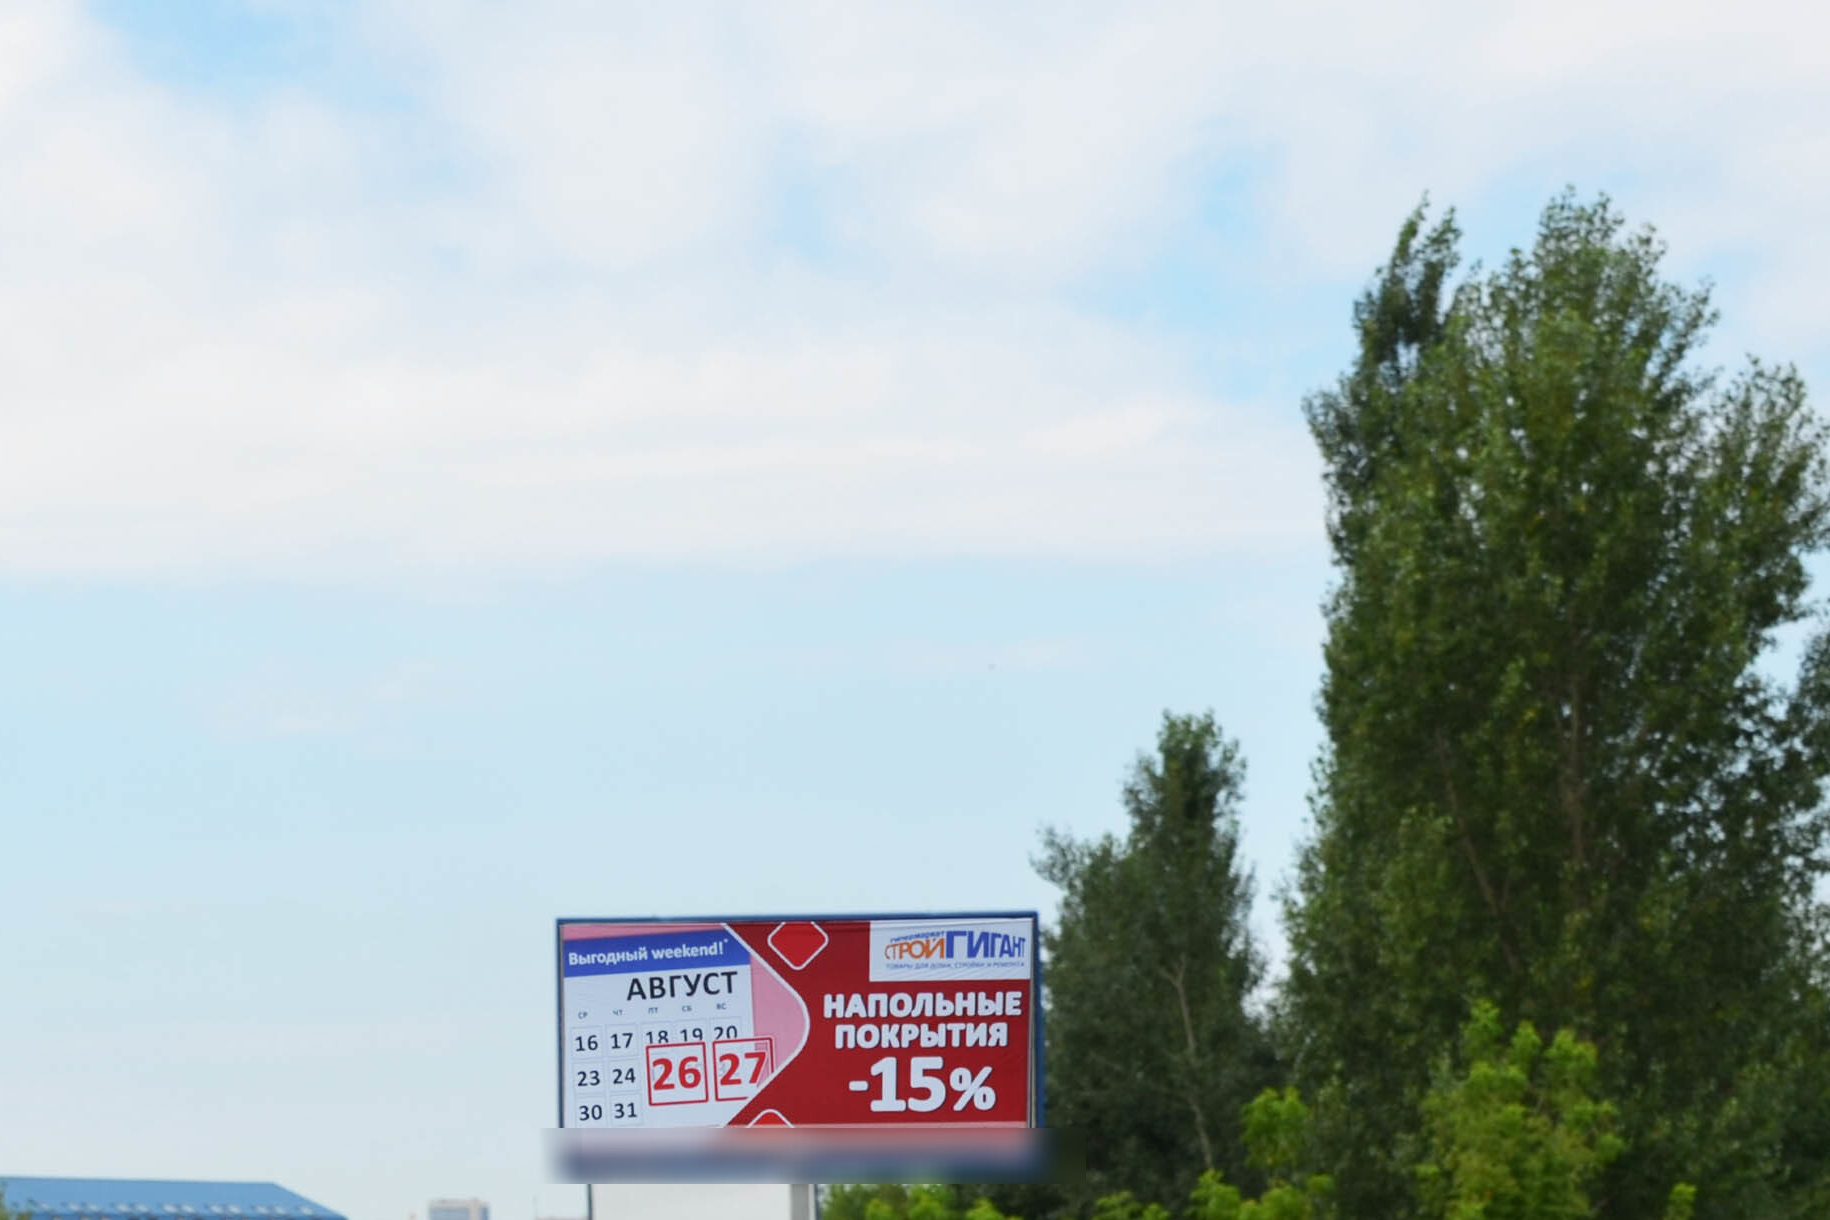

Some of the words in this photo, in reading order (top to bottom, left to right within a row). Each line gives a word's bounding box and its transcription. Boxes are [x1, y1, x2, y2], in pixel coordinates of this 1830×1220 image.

[569, 946, 648, 966] Выгодный
[627, 971, 738, 1001] АВГУСТ
[577, 1011, 589, 1019] СР
[648, 1007, 659, 1015] ПТ
[823, 991, 1023, 1018] НАПОЛЬНЫЕ
[575, 1034, 599, 1052] 16
[610, 1032, 634, 1049] 17
[645, 1030, 669, 1045] 18
[680, 1028, 704, 1042] 19
[714, 1025, 738, 1040] 20
[834, 1022, 1009, 1049] ПОКРЫТИЯ
[577, 1070, 601, 1086] 23
[612, 1068, 636, 1085] 24
[652, 1056, 702, 1091] 26
[719, 1051, 767, 1086] 27
[848, 1056, 997, 1112] -15%
[578, 1104, 603, 1121] 30
[613, 1102, 638, 1119] 31
